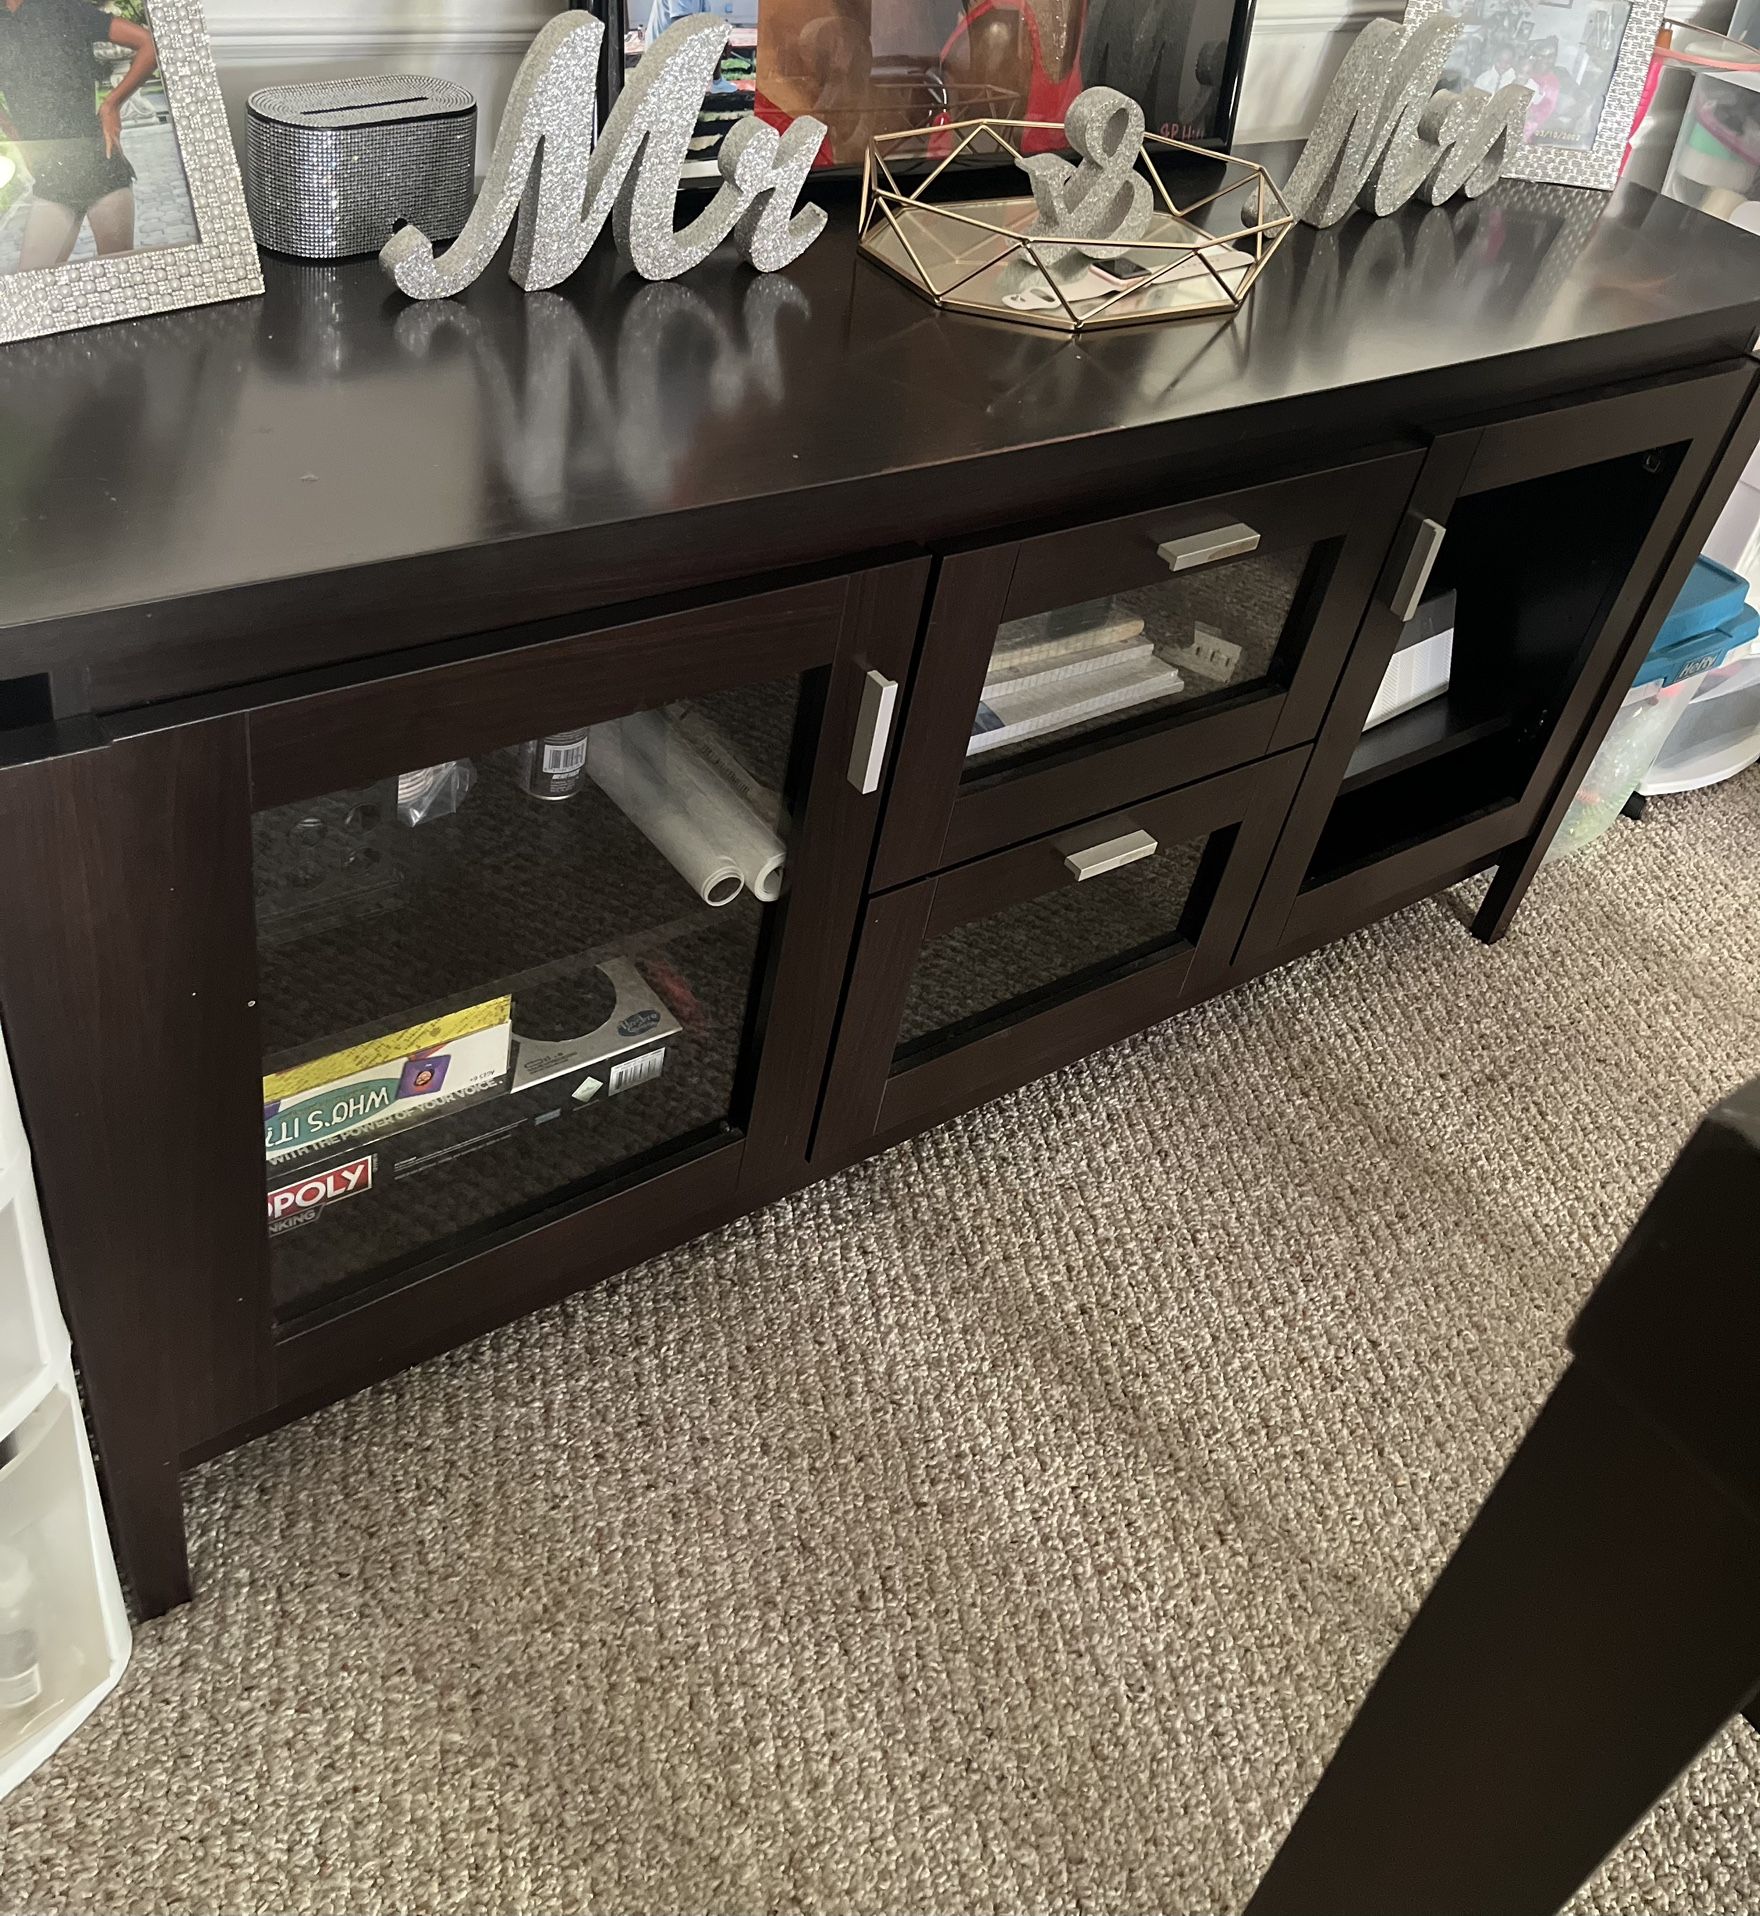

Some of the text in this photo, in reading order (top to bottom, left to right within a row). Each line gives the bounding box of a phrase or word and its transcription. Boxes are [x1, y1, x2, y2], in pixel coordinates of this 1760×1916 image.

[379, 10, 828, 300] Mr
[1005, 86, 1154, 267] &
[1242, 15, 1535, 239] Mrs
[1679, 656, 1718, 678] Hefty
[265, 1086, 389, 1147] WHO'S IT?
[269, 1147, 309, 1166] WITH
[311, 1135, 341, 1151] THE
[342, 1116, 395, 1140] POWER
[396, 1108, 416, 1120] OF
[418, 1094, 456, 1112] YOUR
